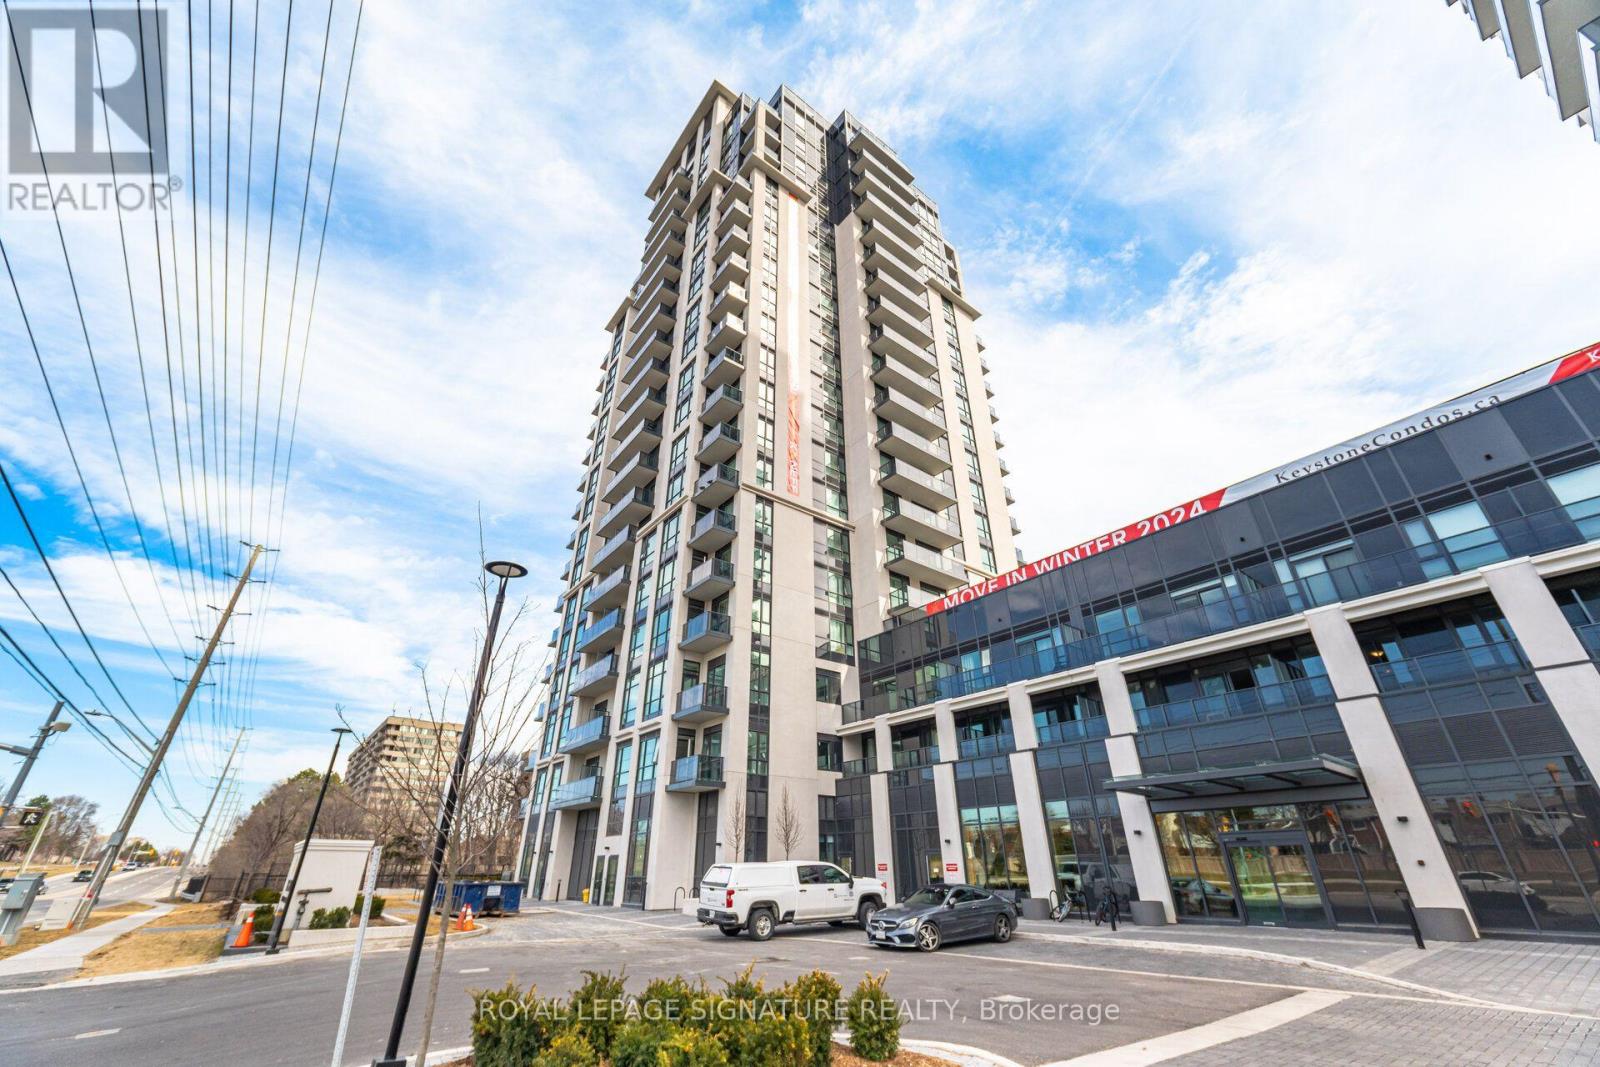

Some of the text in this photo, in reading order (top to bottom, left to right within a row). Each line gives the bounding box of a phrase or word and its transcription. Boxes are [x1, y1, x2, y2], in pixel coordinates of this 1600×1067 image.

[1274, 394, 1501, 484] KeystoneCondos.ca
[943, 500, 1206, 610] MOVE IN WINTER 2024
